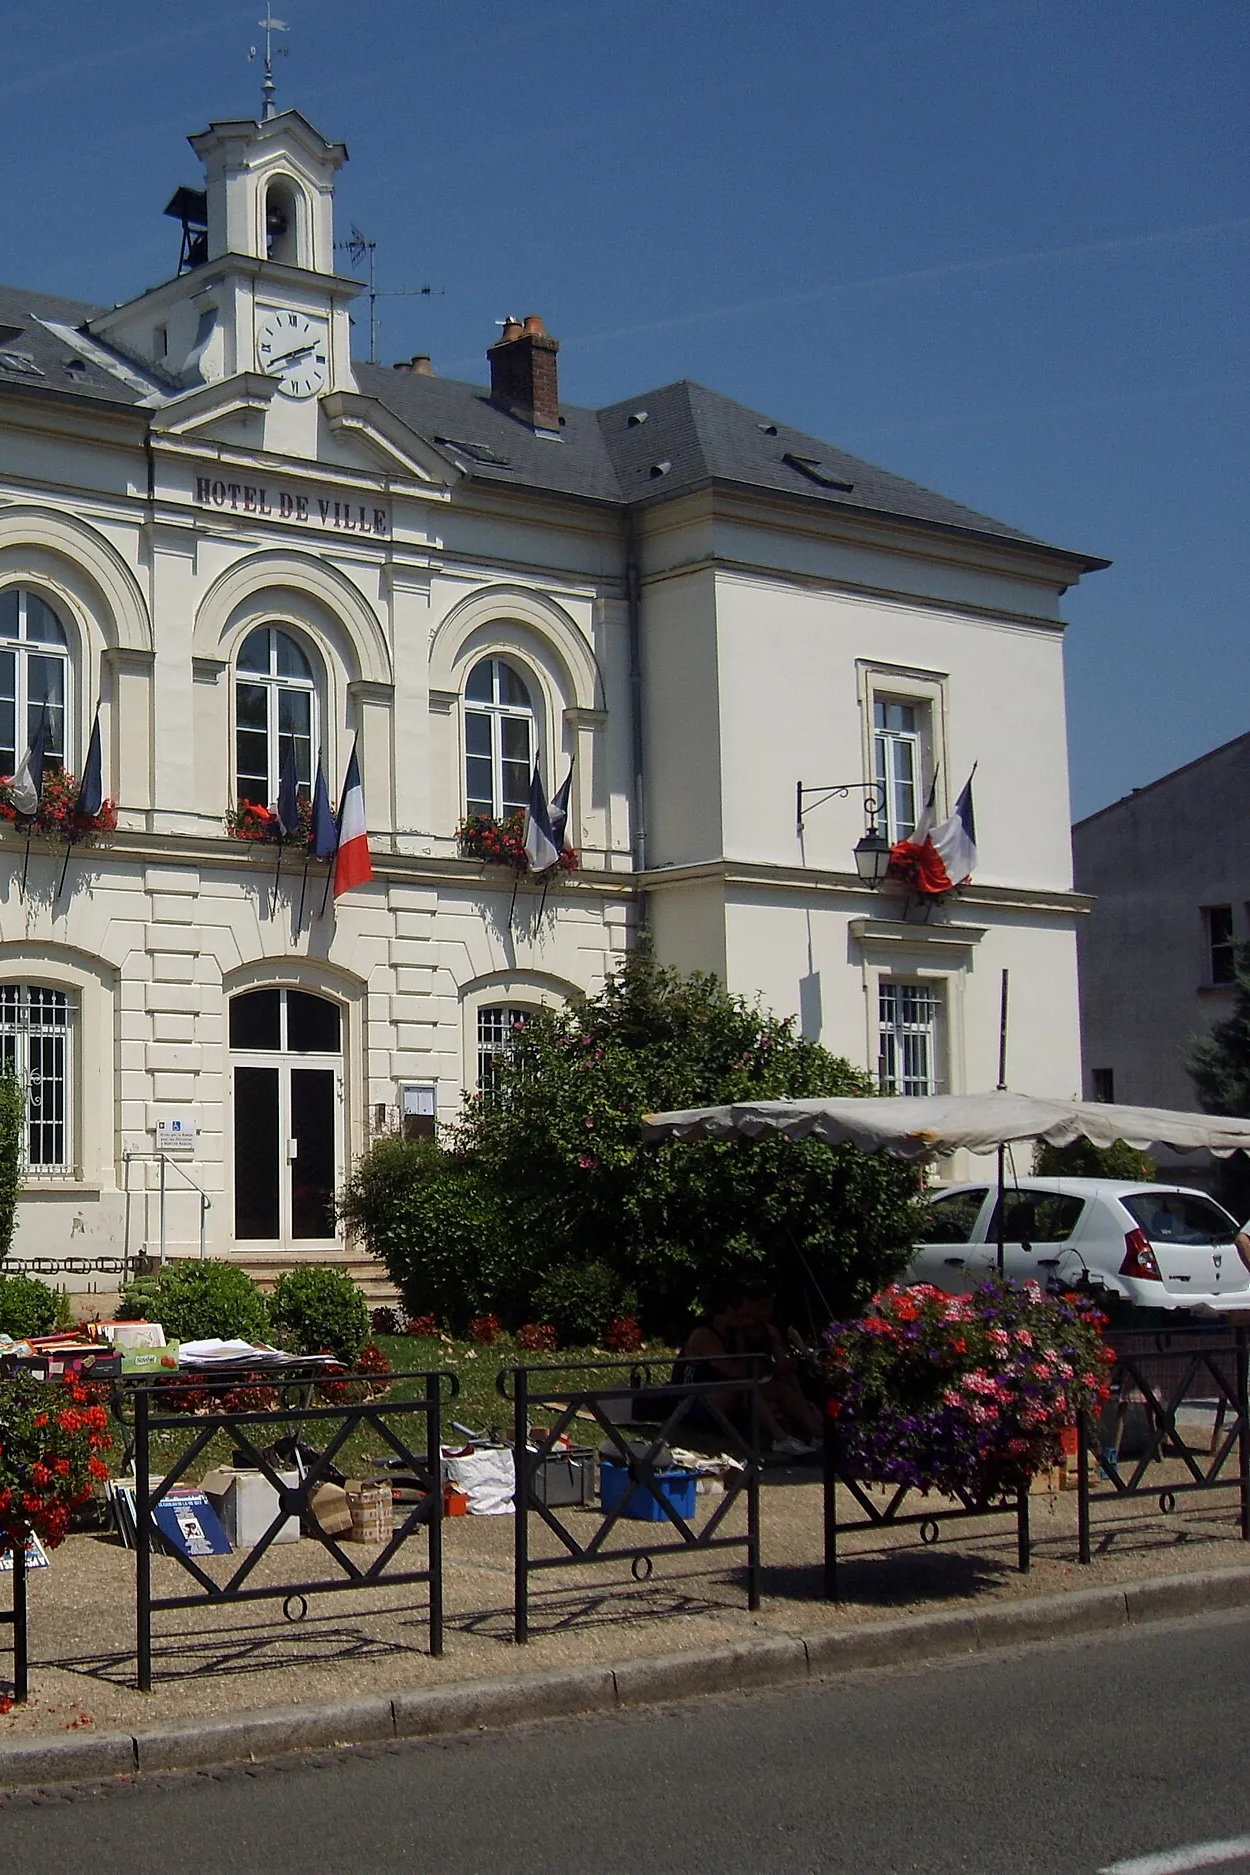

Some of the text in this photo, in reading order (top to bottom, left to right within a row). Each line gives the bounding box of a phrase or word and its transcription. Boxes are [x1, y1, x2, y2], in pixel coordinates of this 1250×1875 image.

[196, 476, 387, 538] HOTEL DE VILLE
